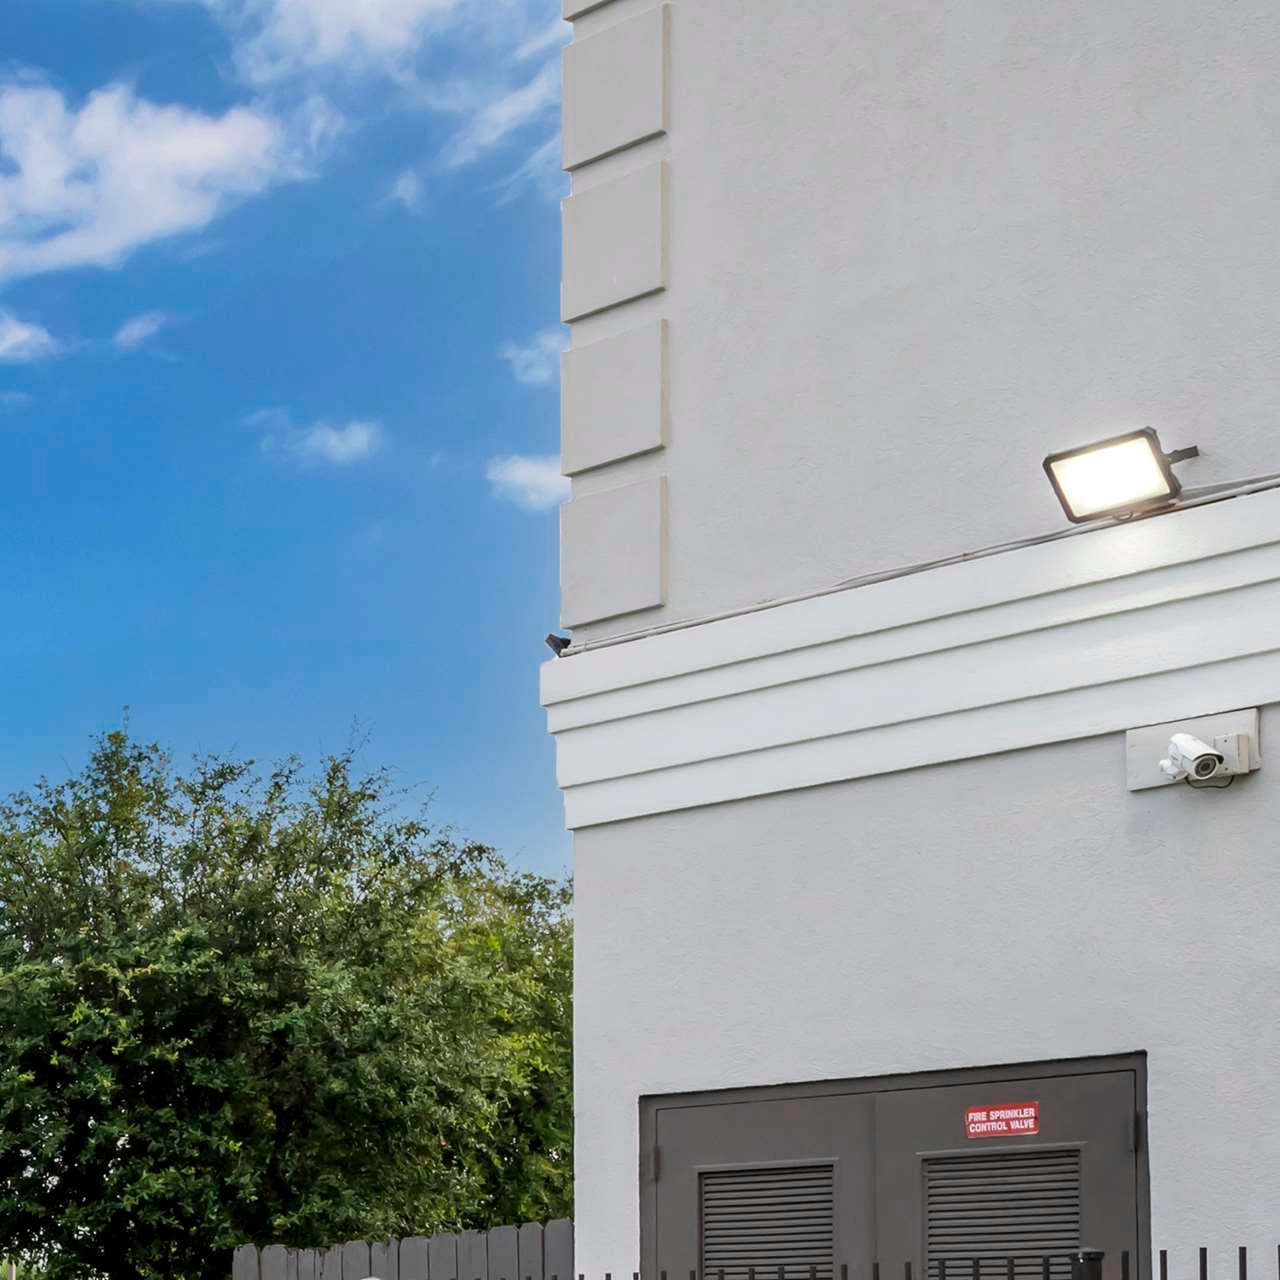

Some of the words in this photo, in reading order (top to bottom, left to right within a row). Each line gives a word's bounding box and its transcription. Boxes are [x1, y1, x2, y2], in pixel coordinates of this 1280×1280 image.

[968, 1112, 987, 1122] FIRE
[989, 1108, 1035, 1120] SPRINKLER
[969, 1121, 1008, 1133] CONTROL
[1010, 1119, 1035, 1130] VALVE
